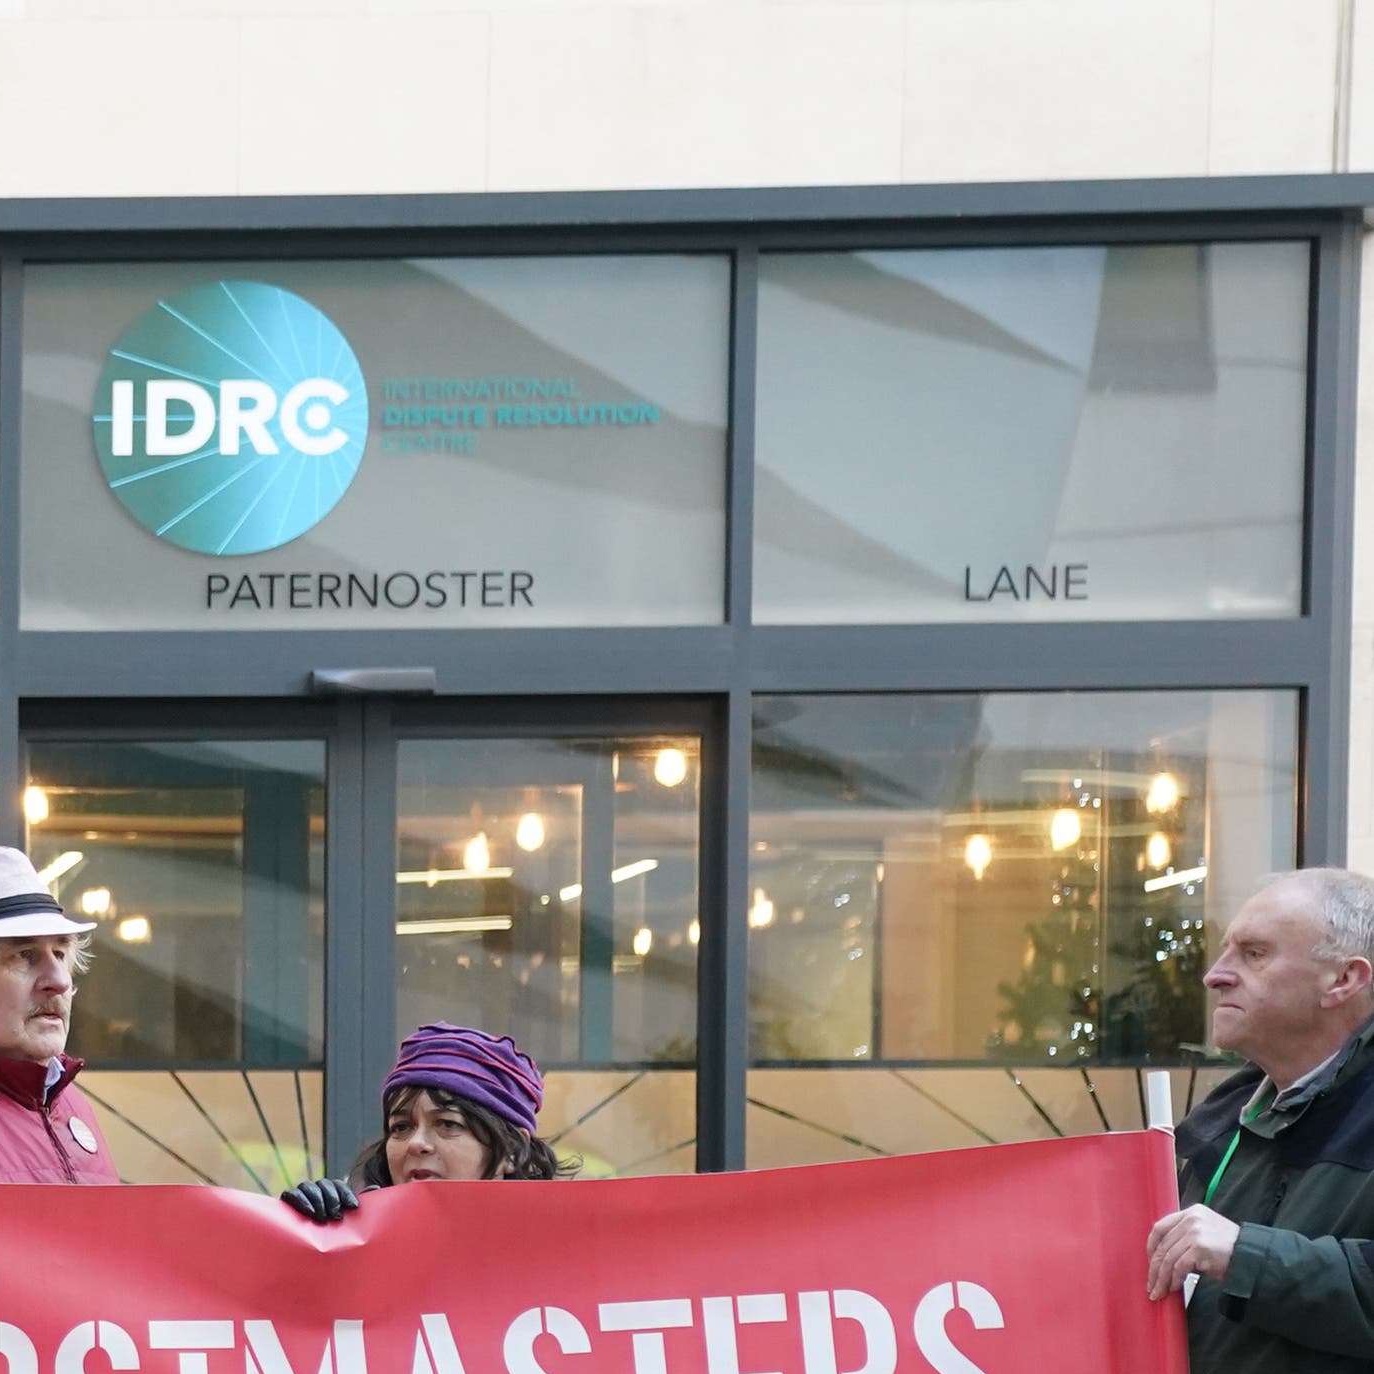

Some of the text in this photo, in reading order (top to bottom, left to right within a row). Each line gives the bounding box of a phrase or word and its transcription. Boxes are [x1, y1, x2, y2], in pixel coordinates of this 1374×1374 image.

[383, 376, 579, 400] INTERNATIONAL
[111, 377, 349, 457] IDRC
[383, 401, 660, 427] DISPUTE RESOLUTION
[382, 431, 479, 454] CENTRE
[205, 571, 535, 610] PATERNOSTER
[963, 564, 1090, 603] LANE
